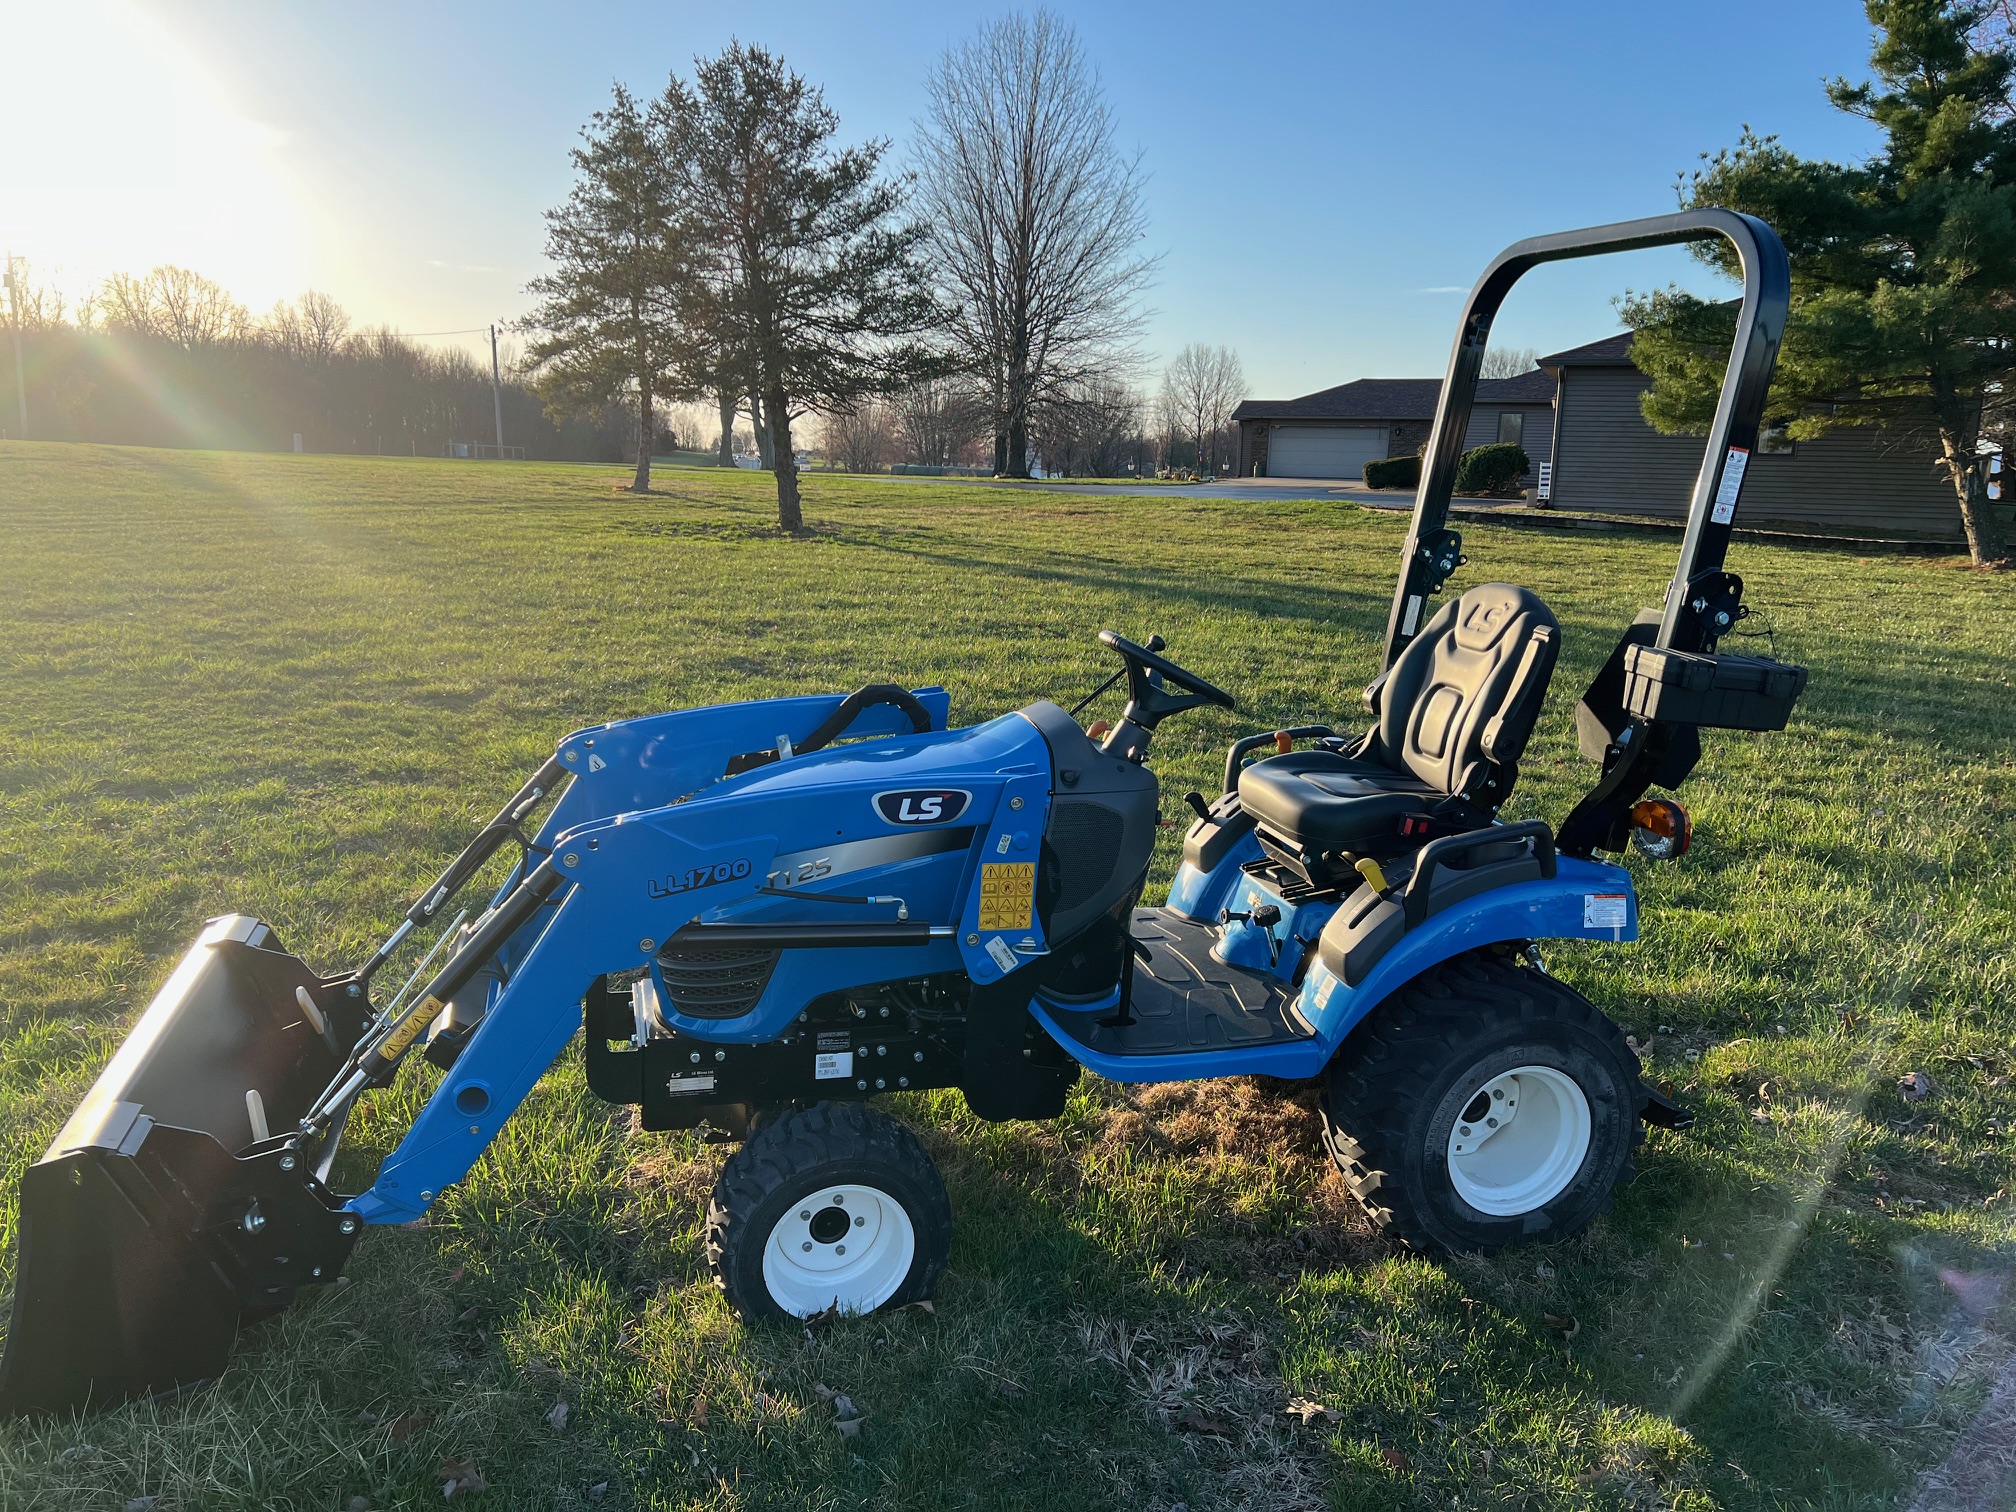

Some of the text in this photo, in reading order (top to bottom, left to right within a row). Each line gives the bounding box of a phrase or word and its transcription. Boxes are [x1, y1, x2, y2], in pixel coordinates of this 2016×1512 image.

[1464, 603, 1504, 633] LS
[899, 795, 945, 821] LS
[648, 858, 752, 899] LL1700
